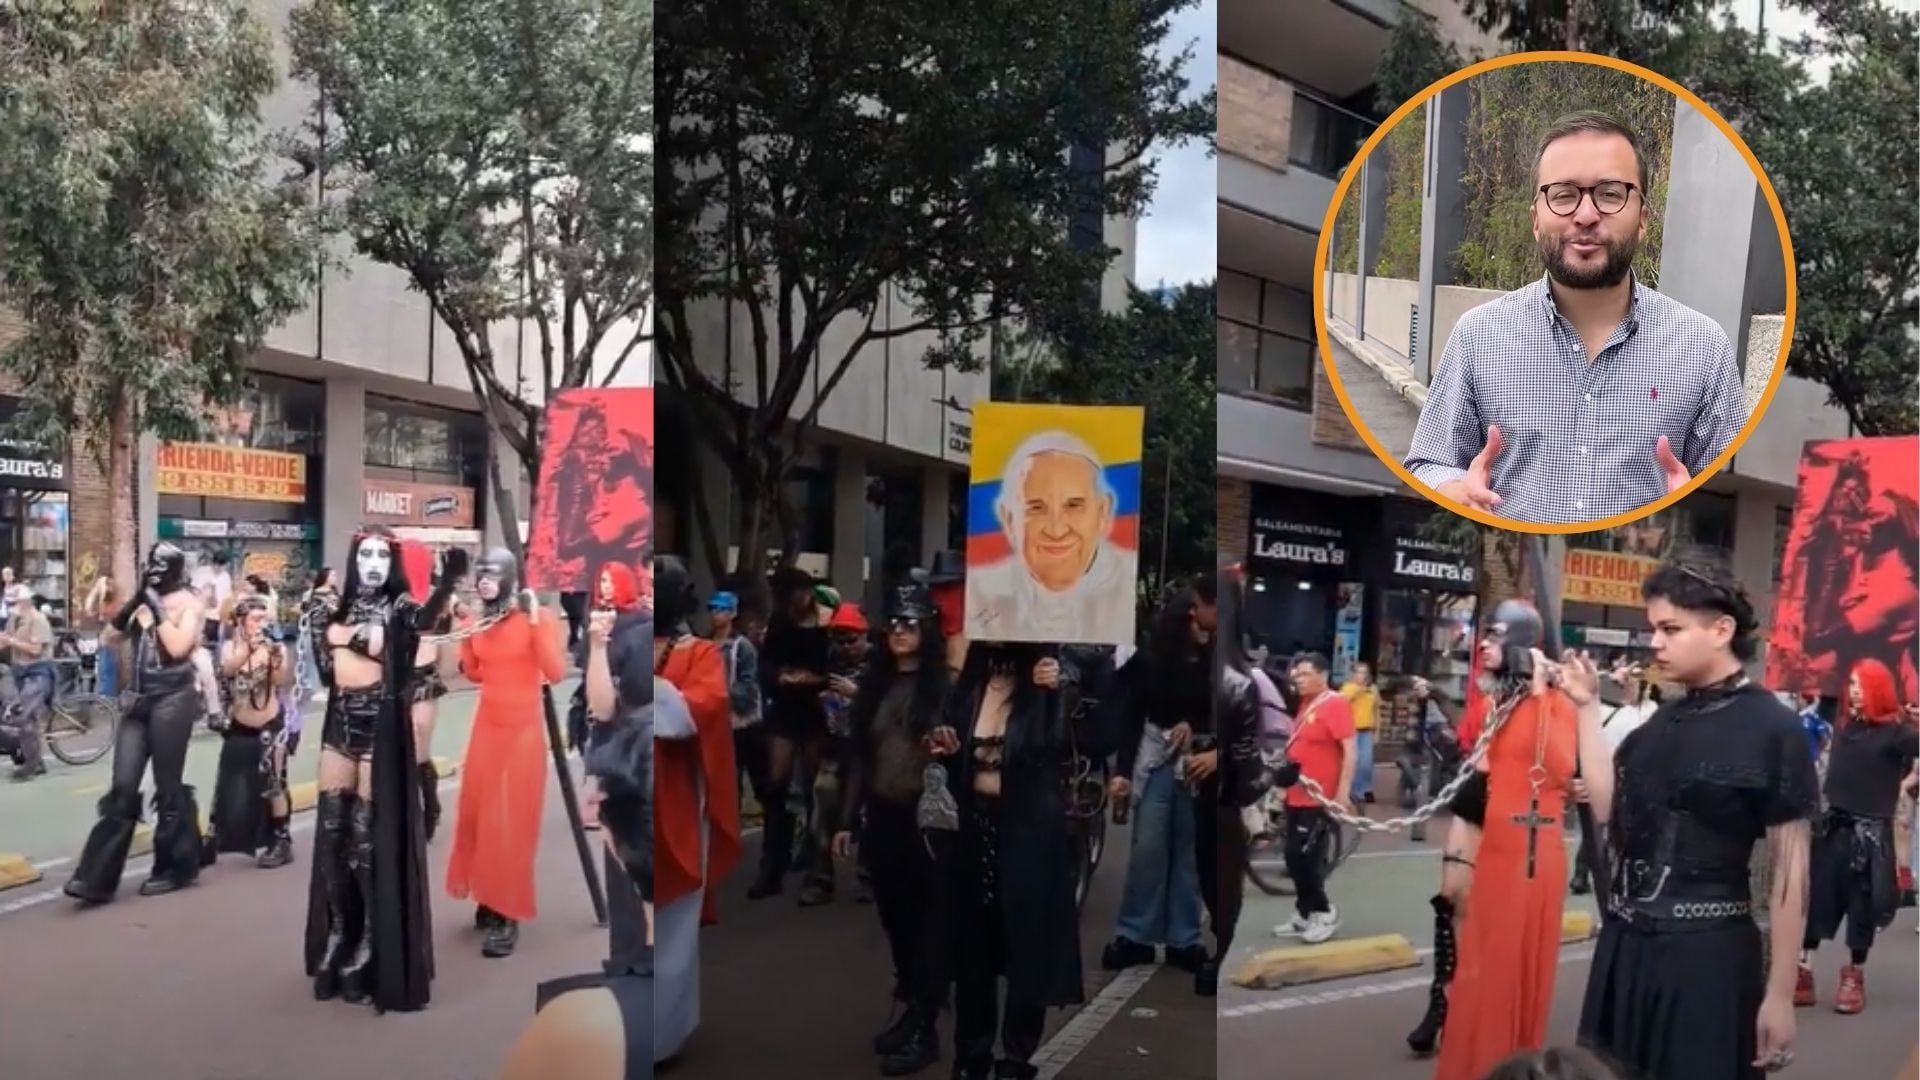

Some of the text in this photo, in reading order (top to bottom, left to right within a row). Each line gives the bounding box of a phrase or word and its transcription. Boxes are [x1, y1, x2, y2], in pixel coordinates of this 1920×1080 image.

[365, 491, 412, 515] MARKET
[1254, 533, 1345, 565] Laura's
[1393, 551, 1474, 581] Laura's
